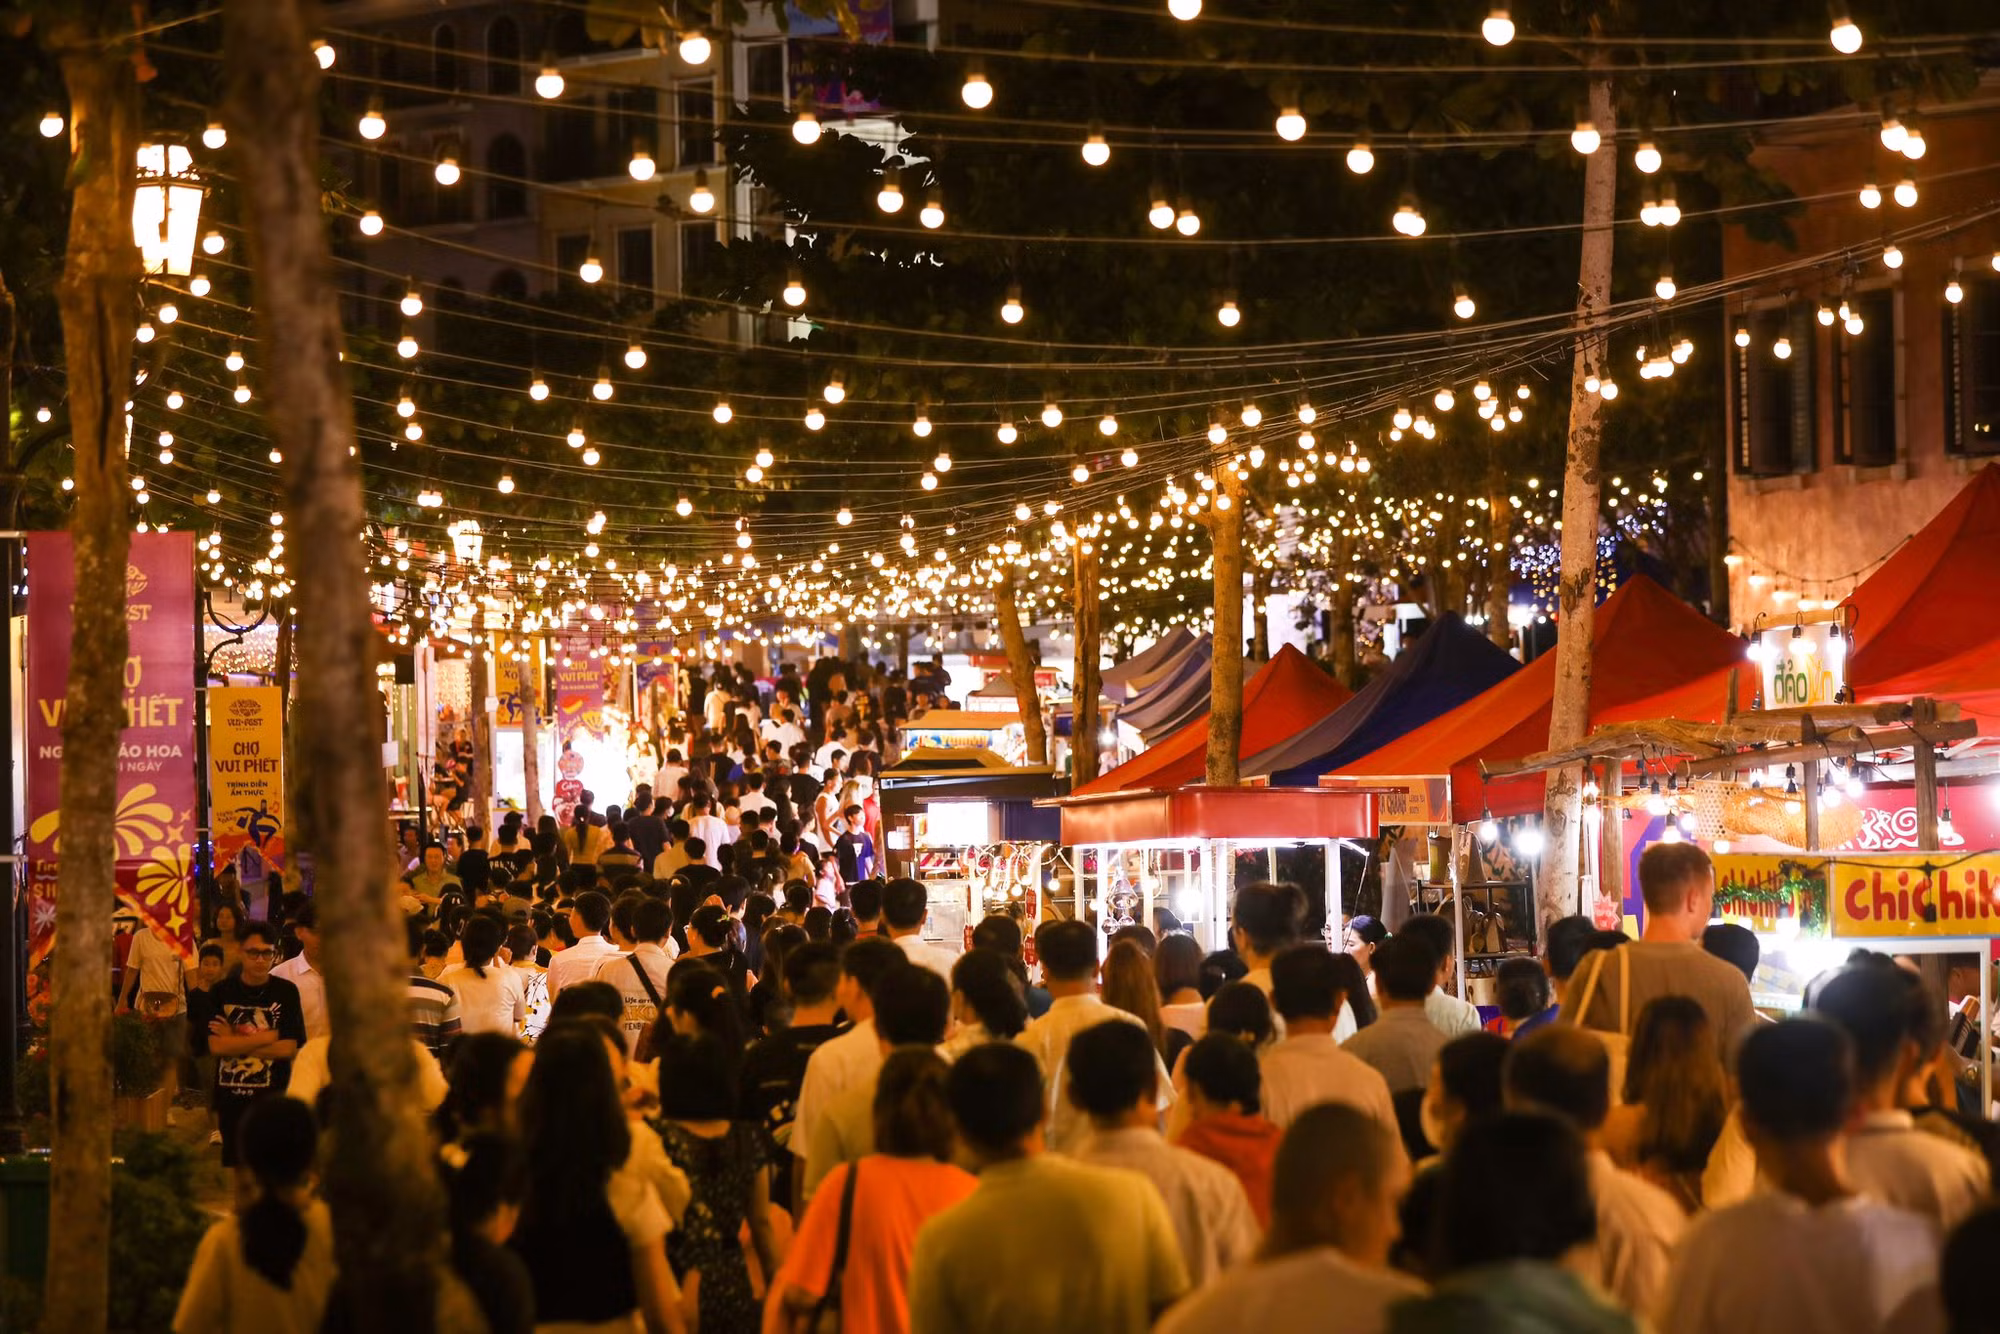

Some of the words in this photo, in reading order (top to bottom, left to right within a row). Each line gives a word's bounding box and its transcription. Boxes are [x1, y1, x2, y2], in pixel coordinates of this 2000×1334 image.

[122, 693, 184, 728] HẾT
[146, 745, 182, 758] HOA
[233, 741, 260, 757] CHỢ
[215, 760, 241, 772] VUI
[244, 757, 278, 772] PHẾT
